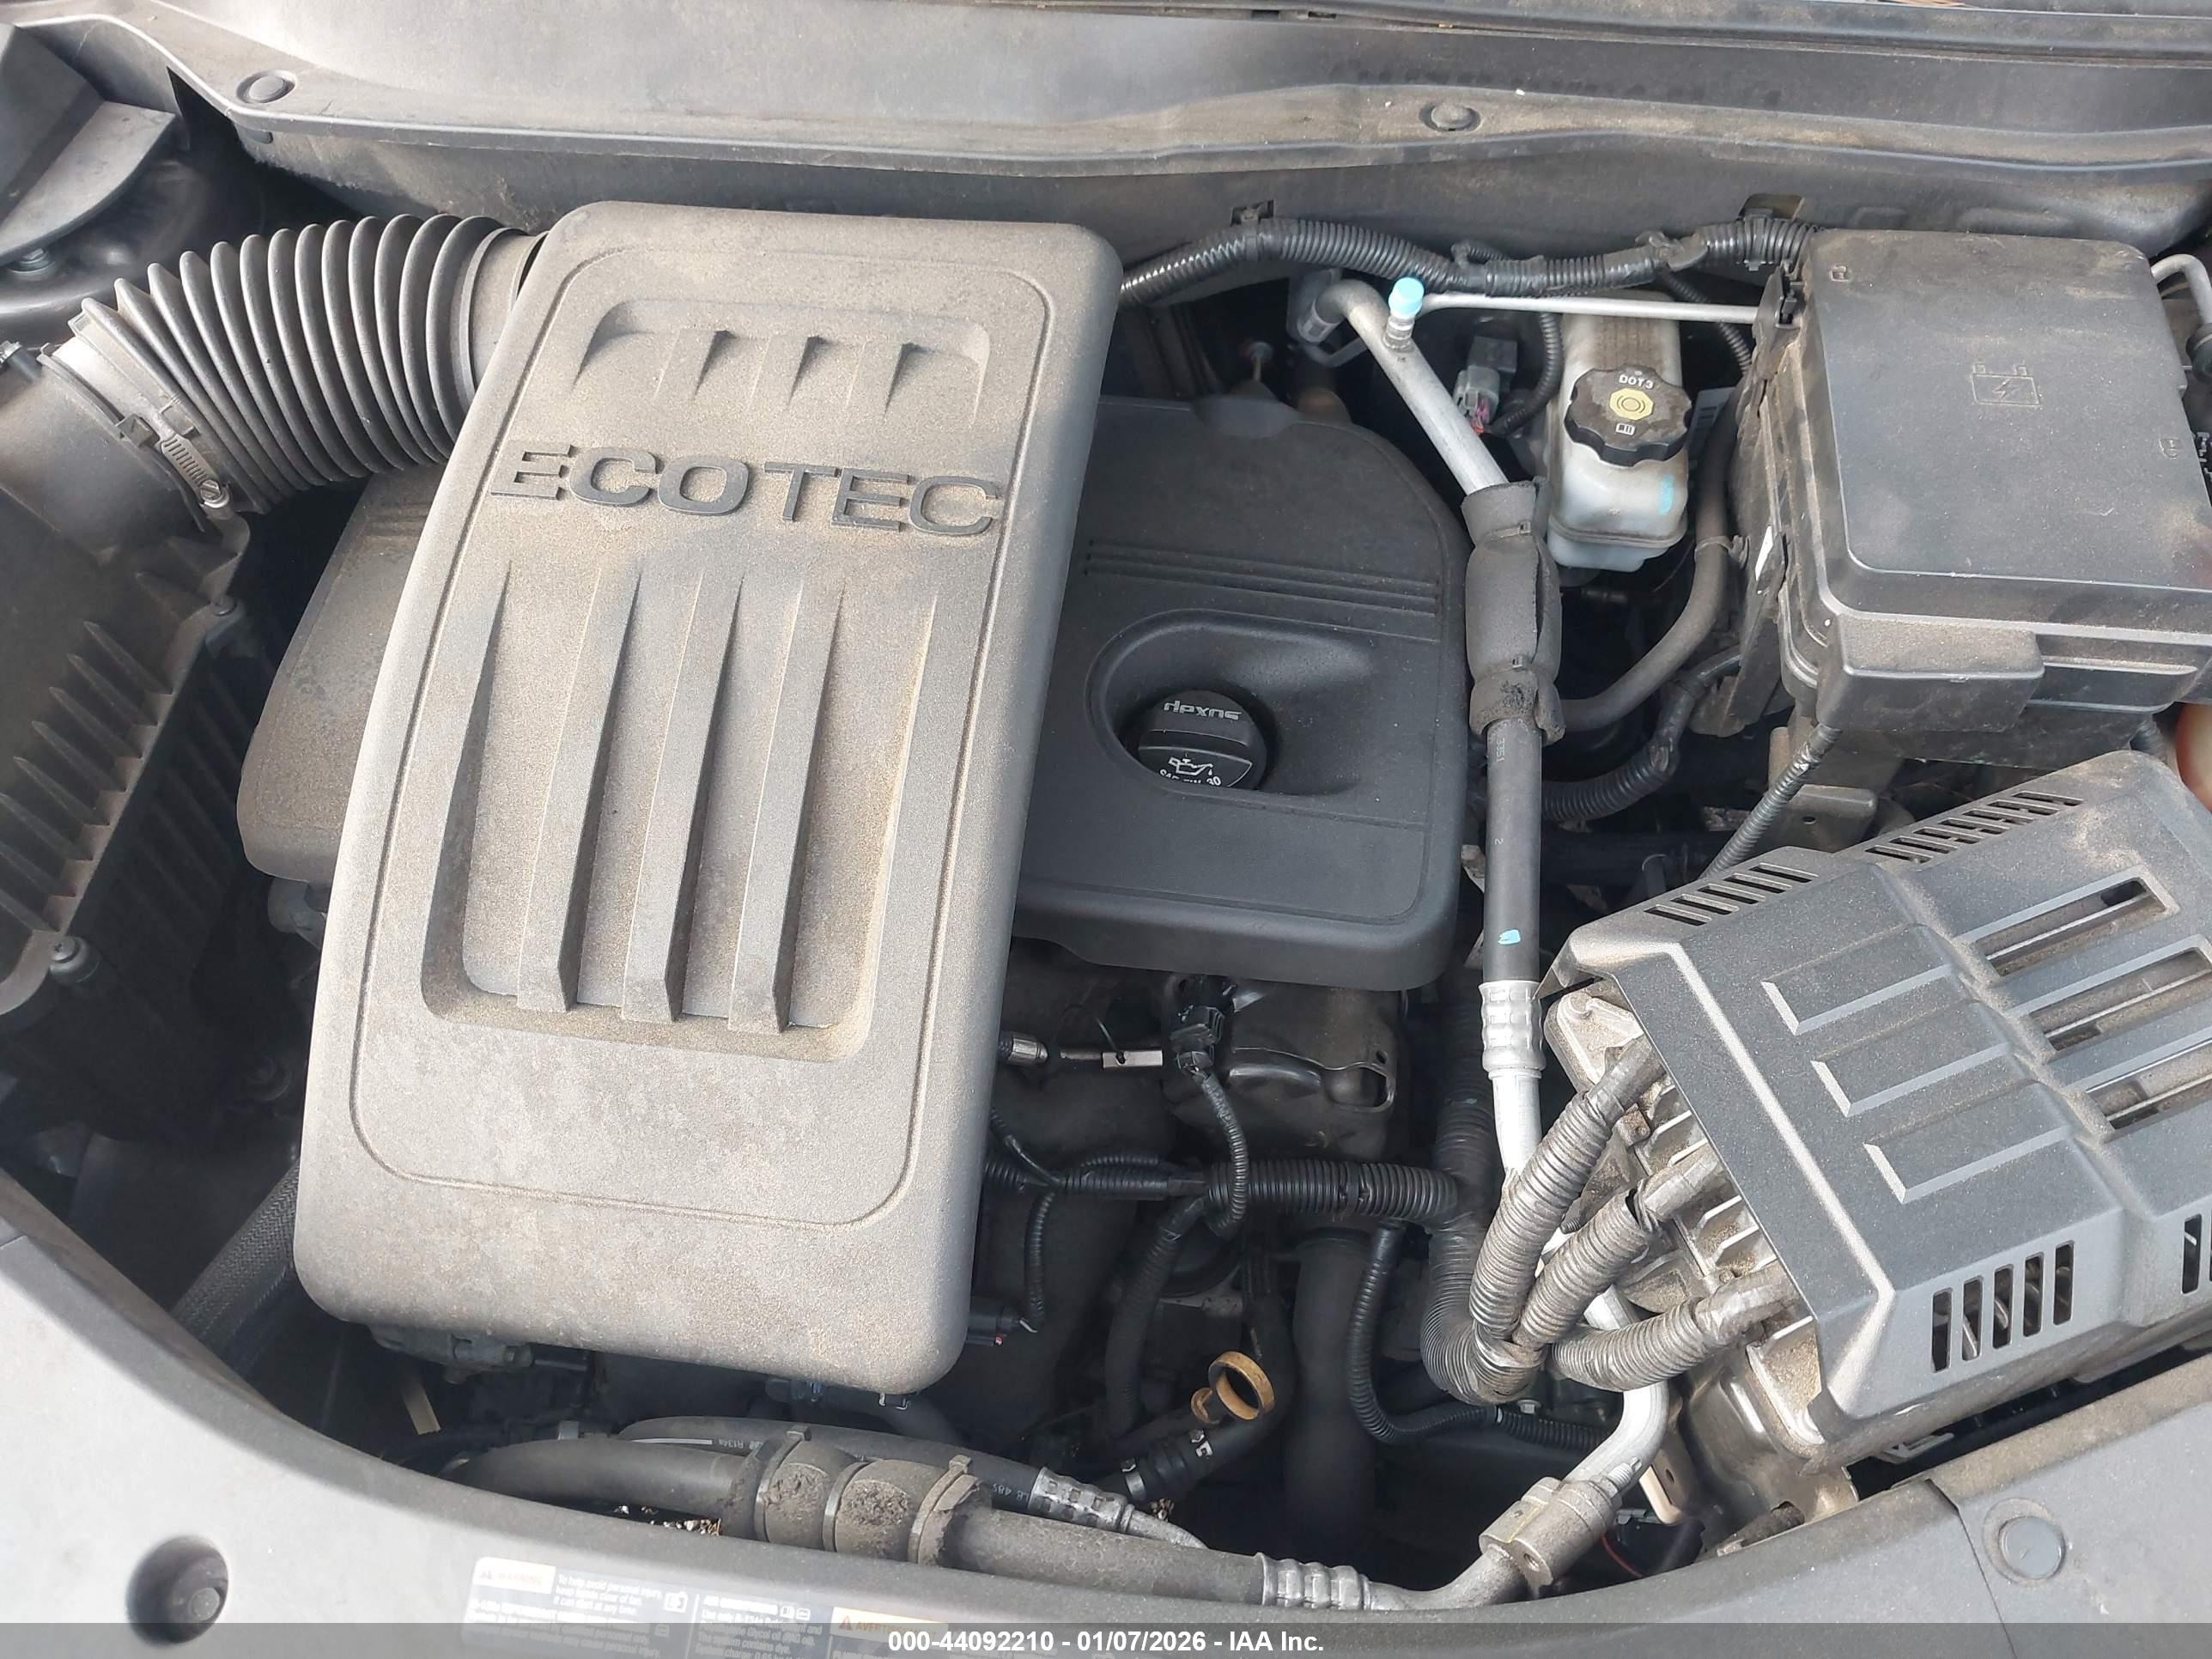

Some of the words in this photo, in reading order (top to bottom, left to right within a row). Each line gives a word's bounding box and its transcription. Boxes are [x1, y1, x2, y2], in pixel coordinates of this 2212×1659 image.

[1619, 374, 1647, 387] DOT
[1645, 380, 1654, 389] 3
[490, 443, 1006, 538] ECOTEC
